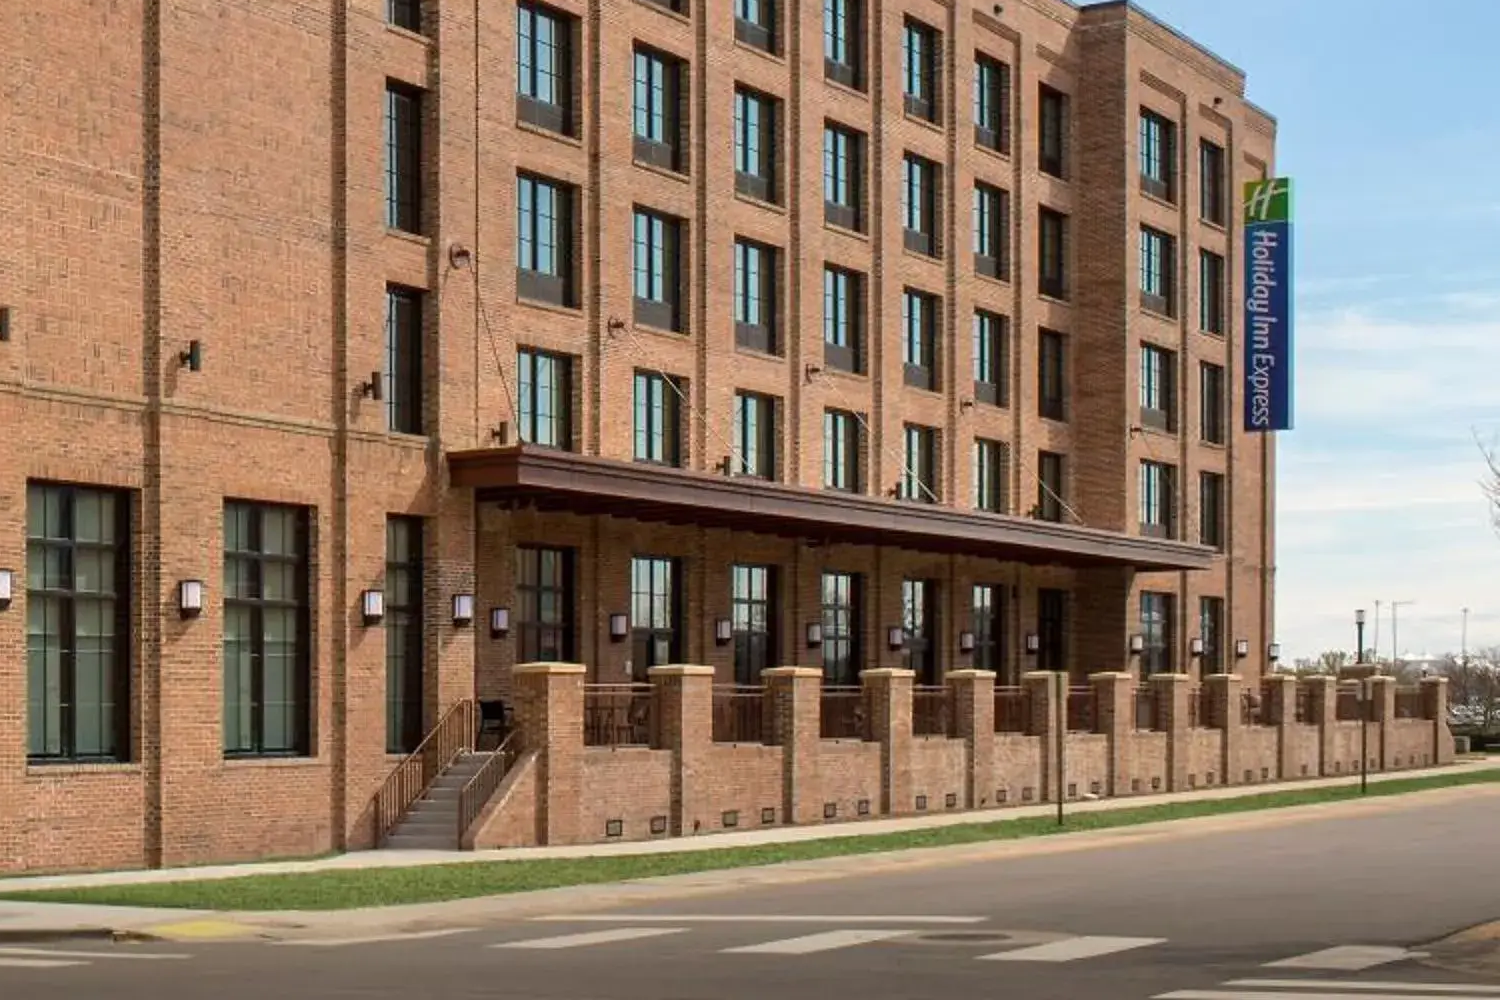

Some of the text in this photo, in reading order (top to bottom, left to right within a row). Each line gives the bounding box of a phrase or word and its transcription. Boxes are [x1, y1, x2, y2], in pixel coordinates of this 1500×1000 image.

[1247, 231, 1278, 427] Holiday Inn Express
